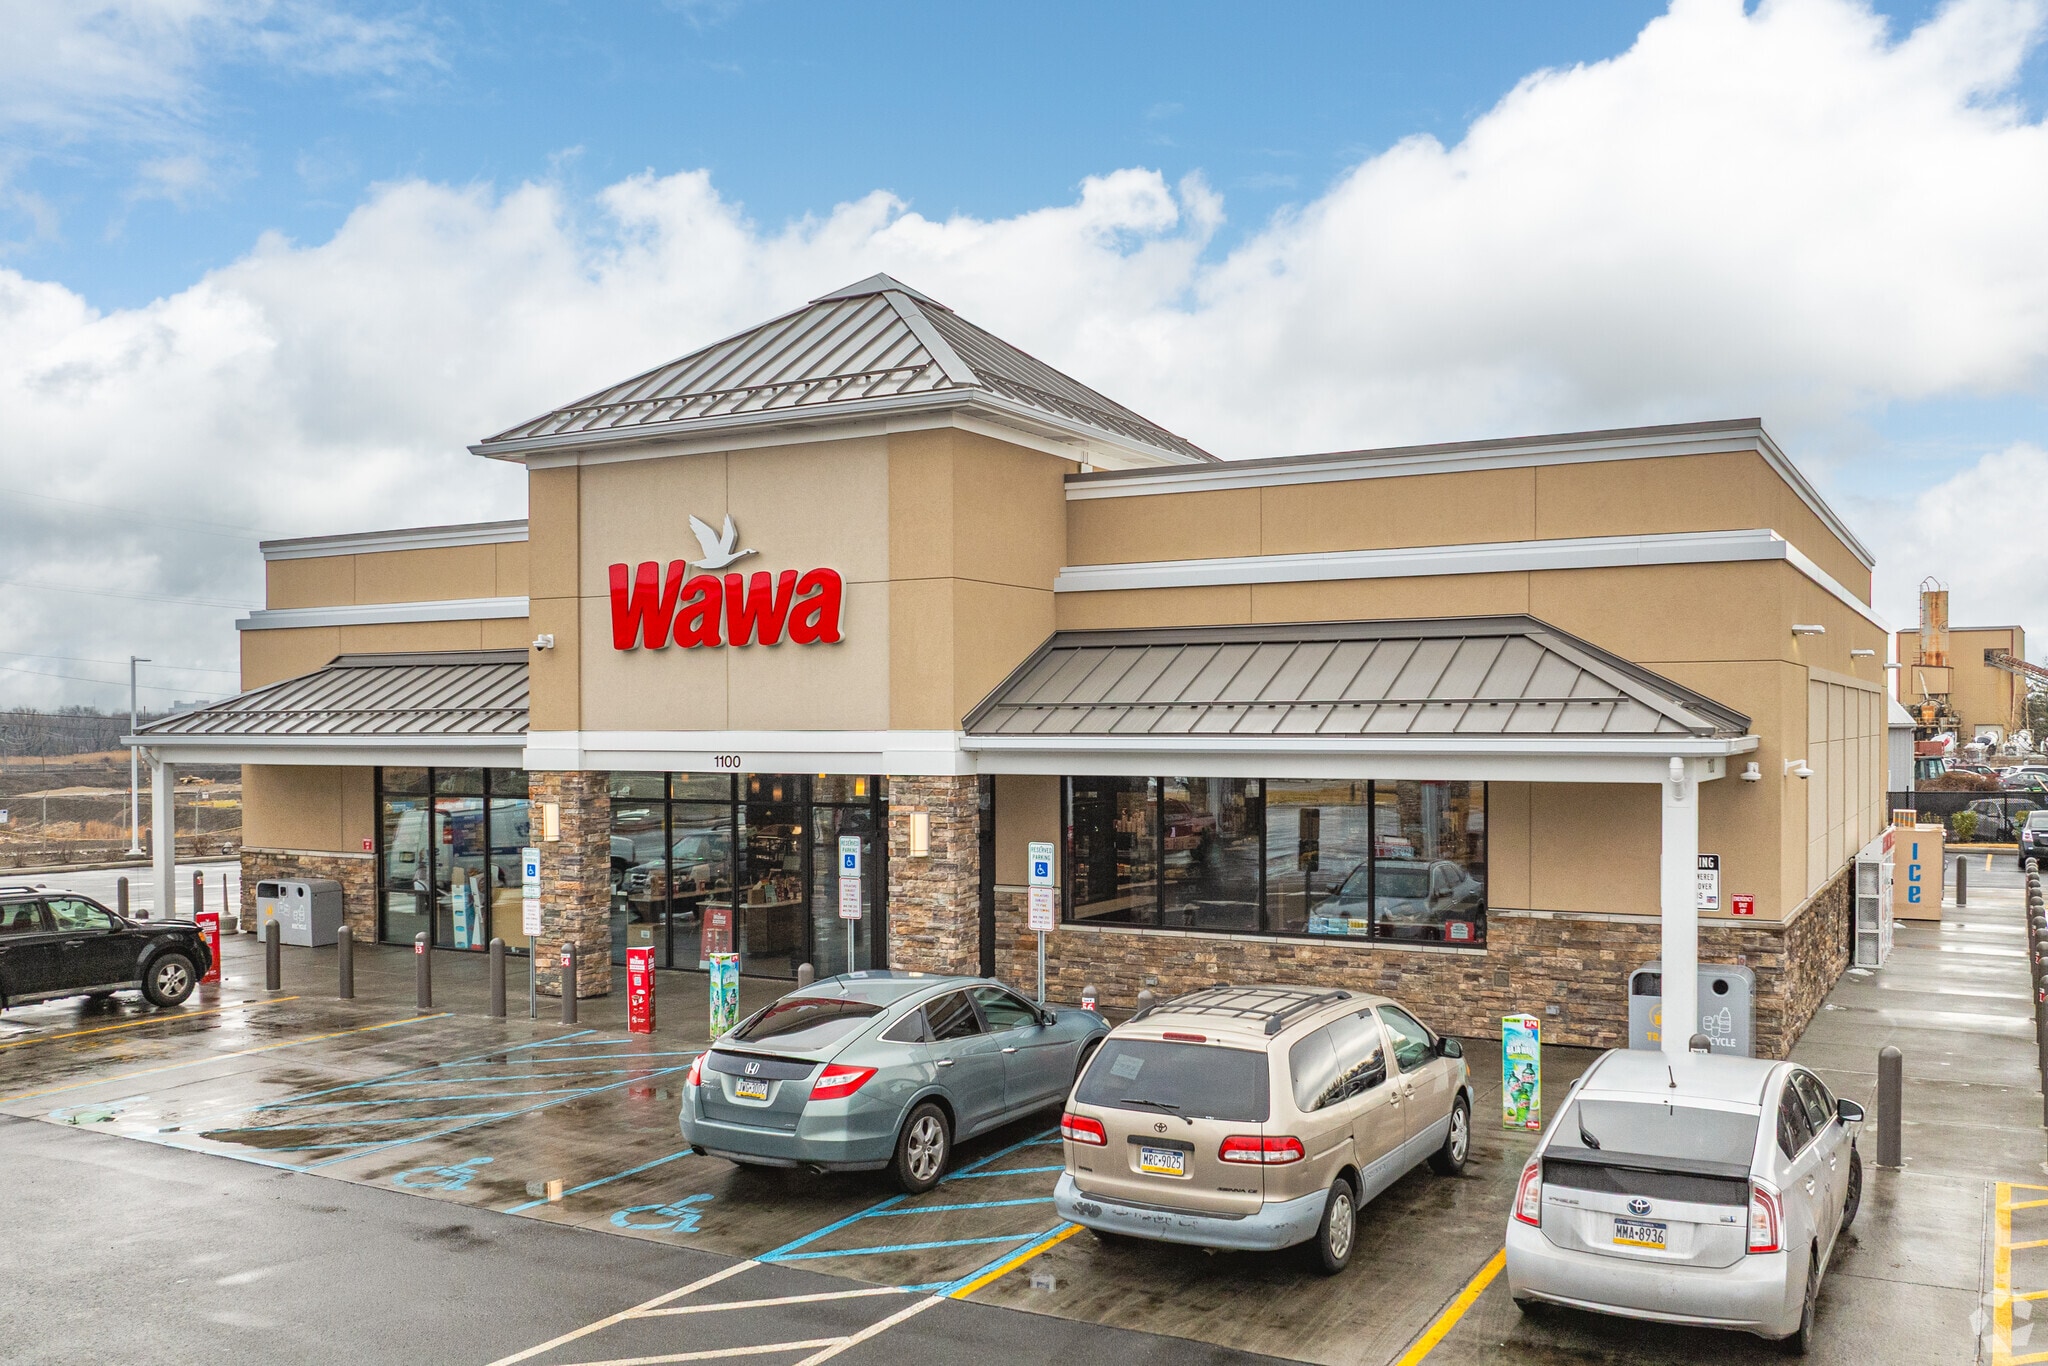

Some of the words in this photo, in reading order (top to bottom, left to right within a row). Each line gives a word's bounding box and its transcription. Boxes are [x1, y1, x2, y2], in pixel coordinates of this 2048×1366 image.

[608, 559, 846, 651] Wawa
[714, 755, 741, 768] 1100
[1031, 846, 1052, 854] RESERVED
[1698, 856, 1715, 868] ING
[1710, 1037, 1737, 1048] CYCLE
